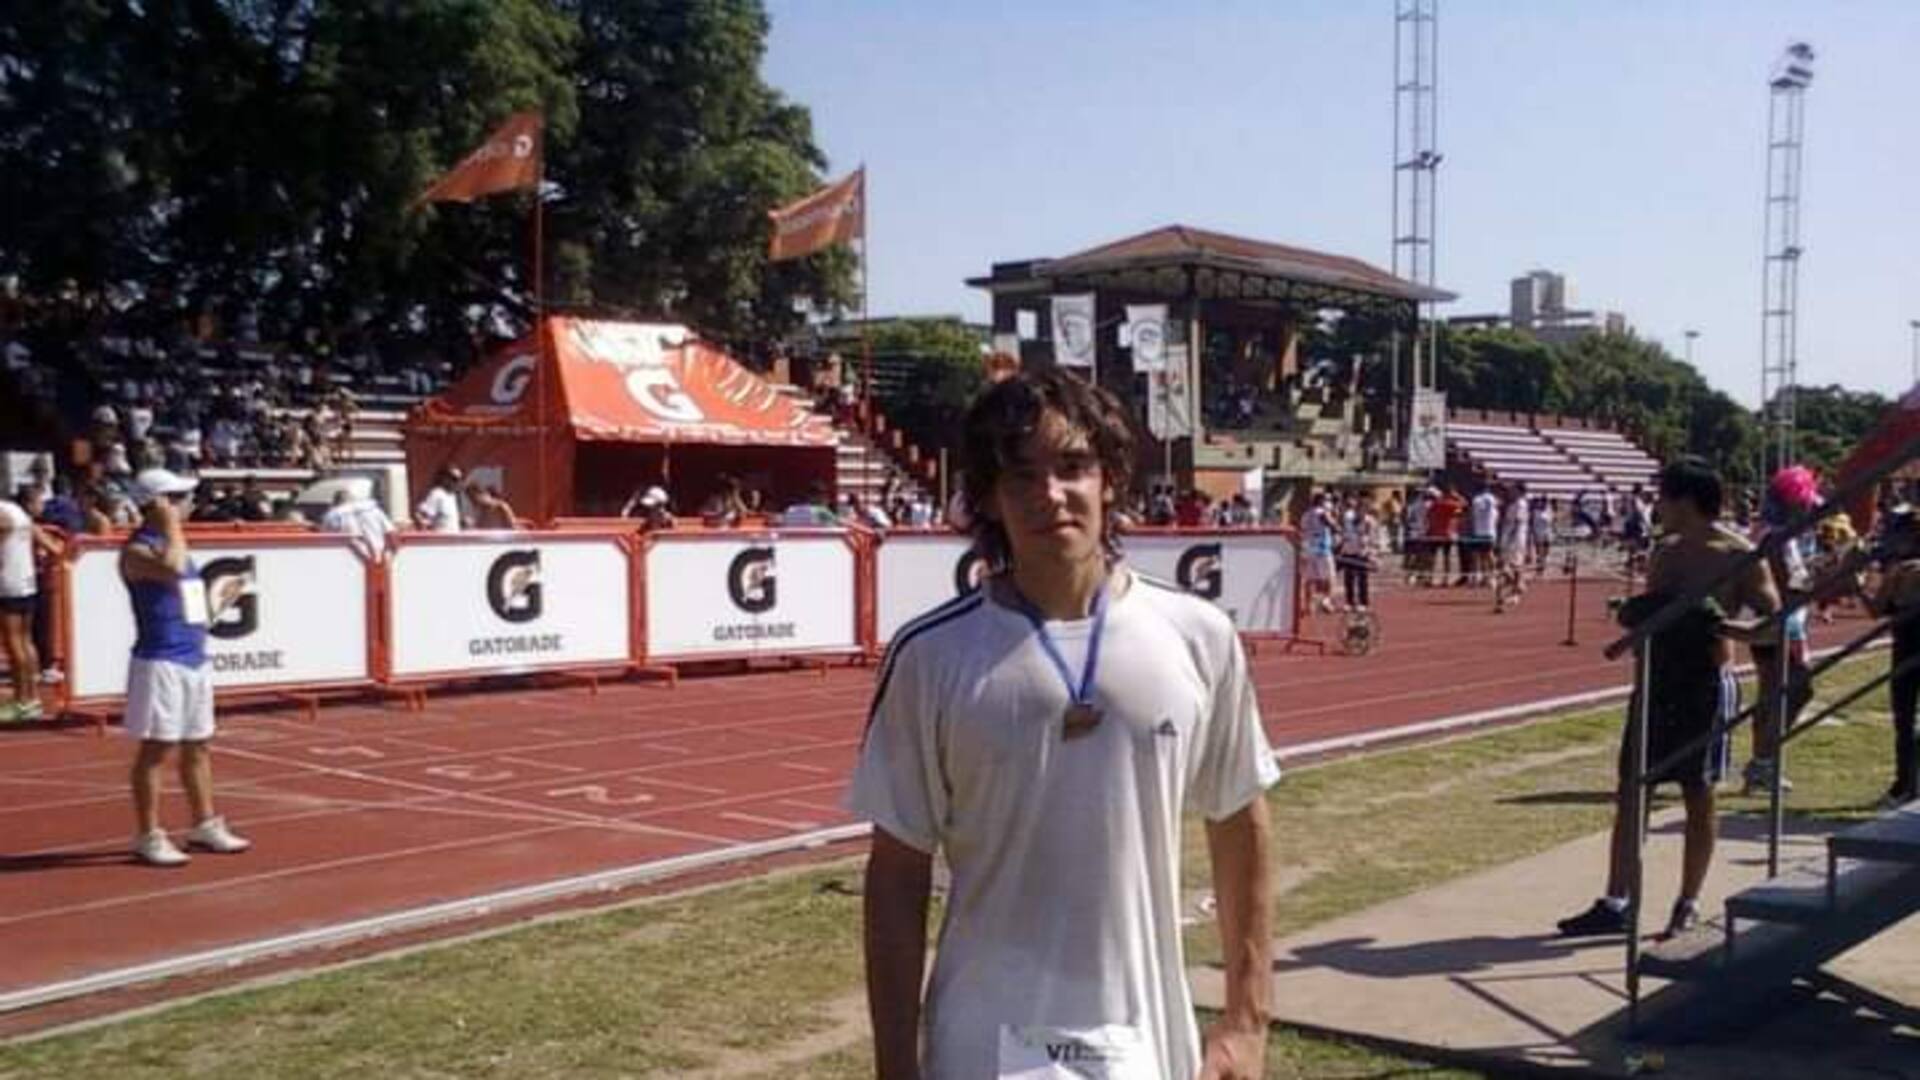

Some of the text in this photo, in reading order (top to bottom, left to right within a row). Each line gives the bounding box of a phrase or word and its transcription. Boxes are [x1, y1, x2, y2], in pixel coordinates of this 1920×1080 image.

[491, 355, 536, 403] G
[625, 367, 704, 421] G
[200, 555, 258, 640] G
[486, 549, 542, 624] G
[728, 546, 777, 614] G
[1176, 543, 1222, 601] G
[212, 650, 284, 672] ORADE
[468, 634, 563, 656] GATORADE
[545, 785, 653, 805] 2
